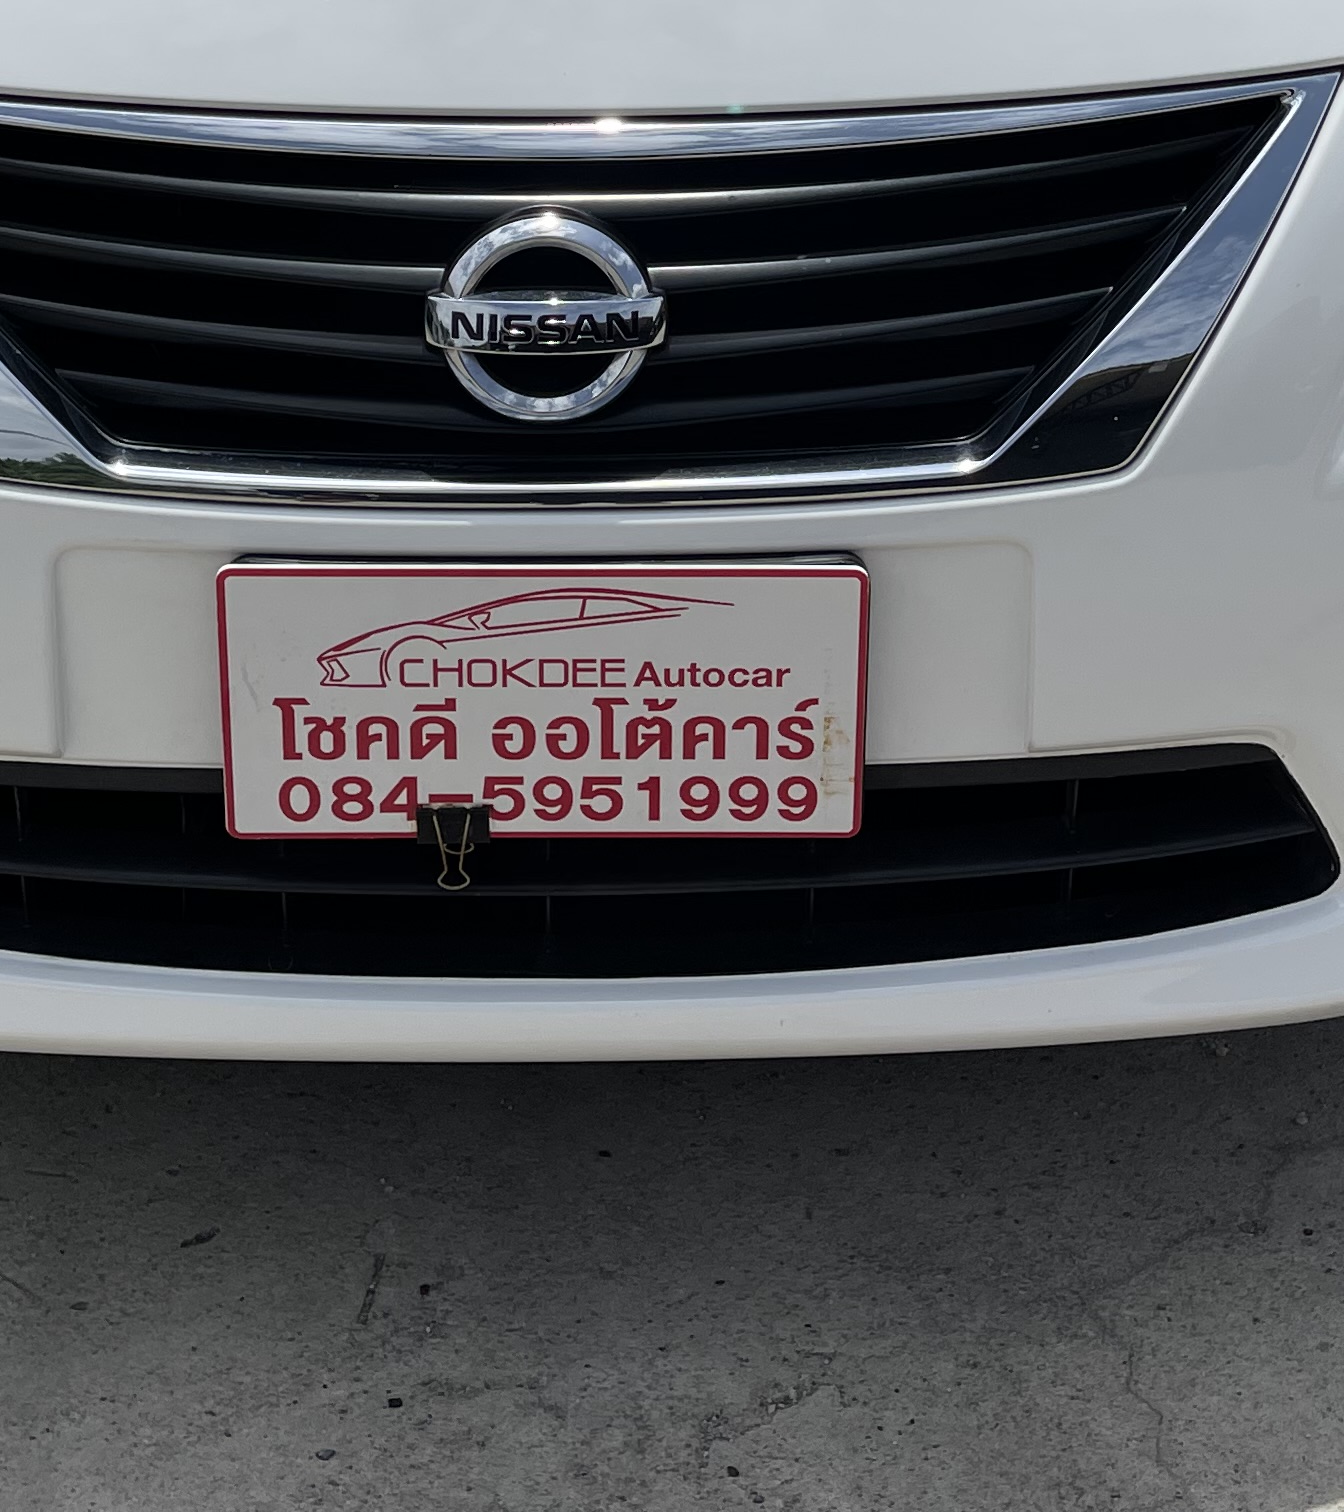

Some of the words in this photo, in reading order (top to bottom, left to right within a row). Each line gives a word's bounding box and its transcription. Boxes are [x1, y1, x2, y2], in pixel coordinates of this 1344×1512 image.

[451, 311, 639, 344] NISSAN
[399, 658, 625, 688] CHOKDEE
[634, 661, 790, 688] Autocar
[272, 697, 458, 761] โชคดี
[491, 697, 819, 761] ออโต้คาร์
[278, 775, 819, 822] 084-5951999
